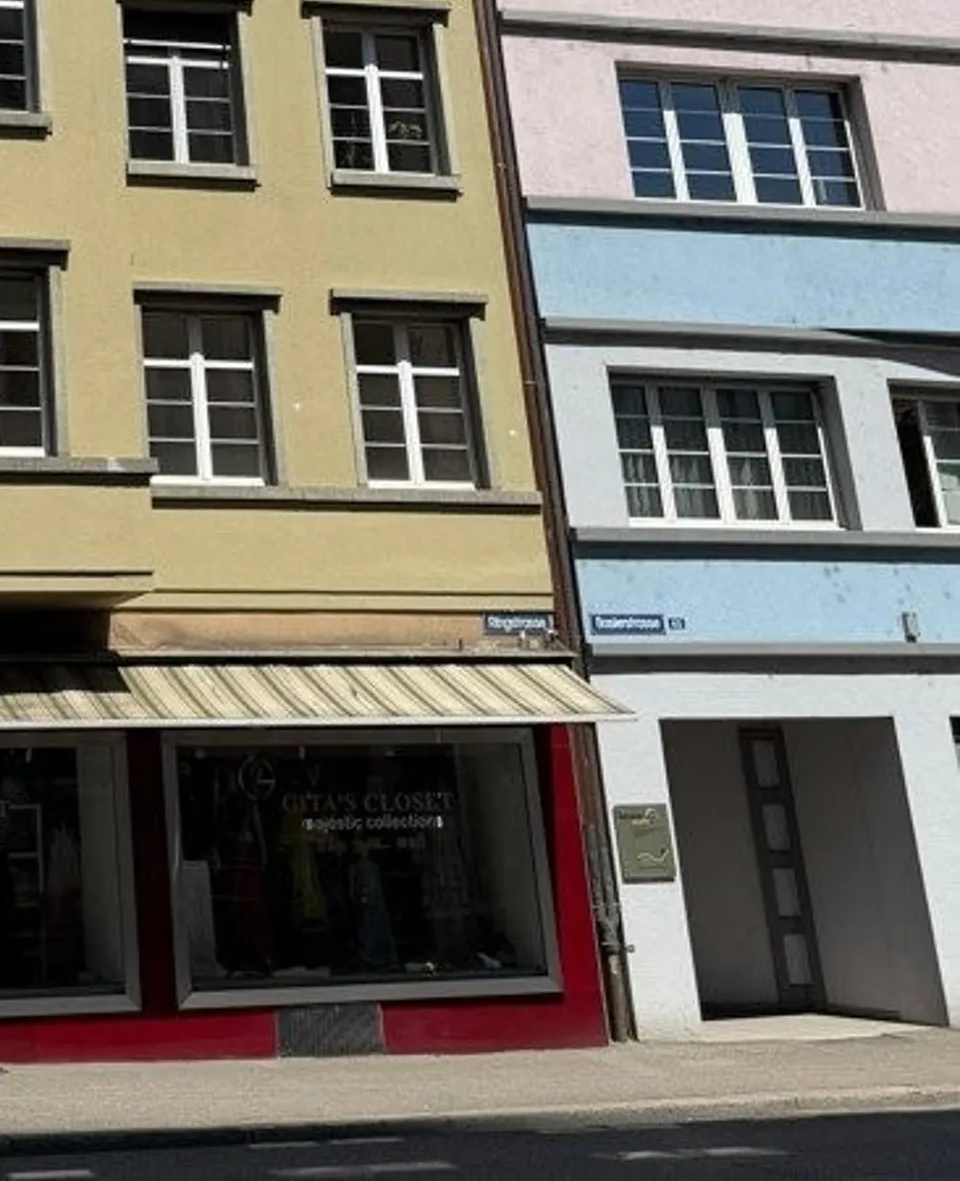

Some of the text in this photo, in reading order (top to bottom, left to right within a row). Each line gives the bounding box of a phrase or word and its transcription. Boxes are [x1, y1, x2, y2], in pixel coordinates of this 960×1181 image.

[363, 791, 454, 813] CLOSET
[301, 813, 444, 833] majestic collections
